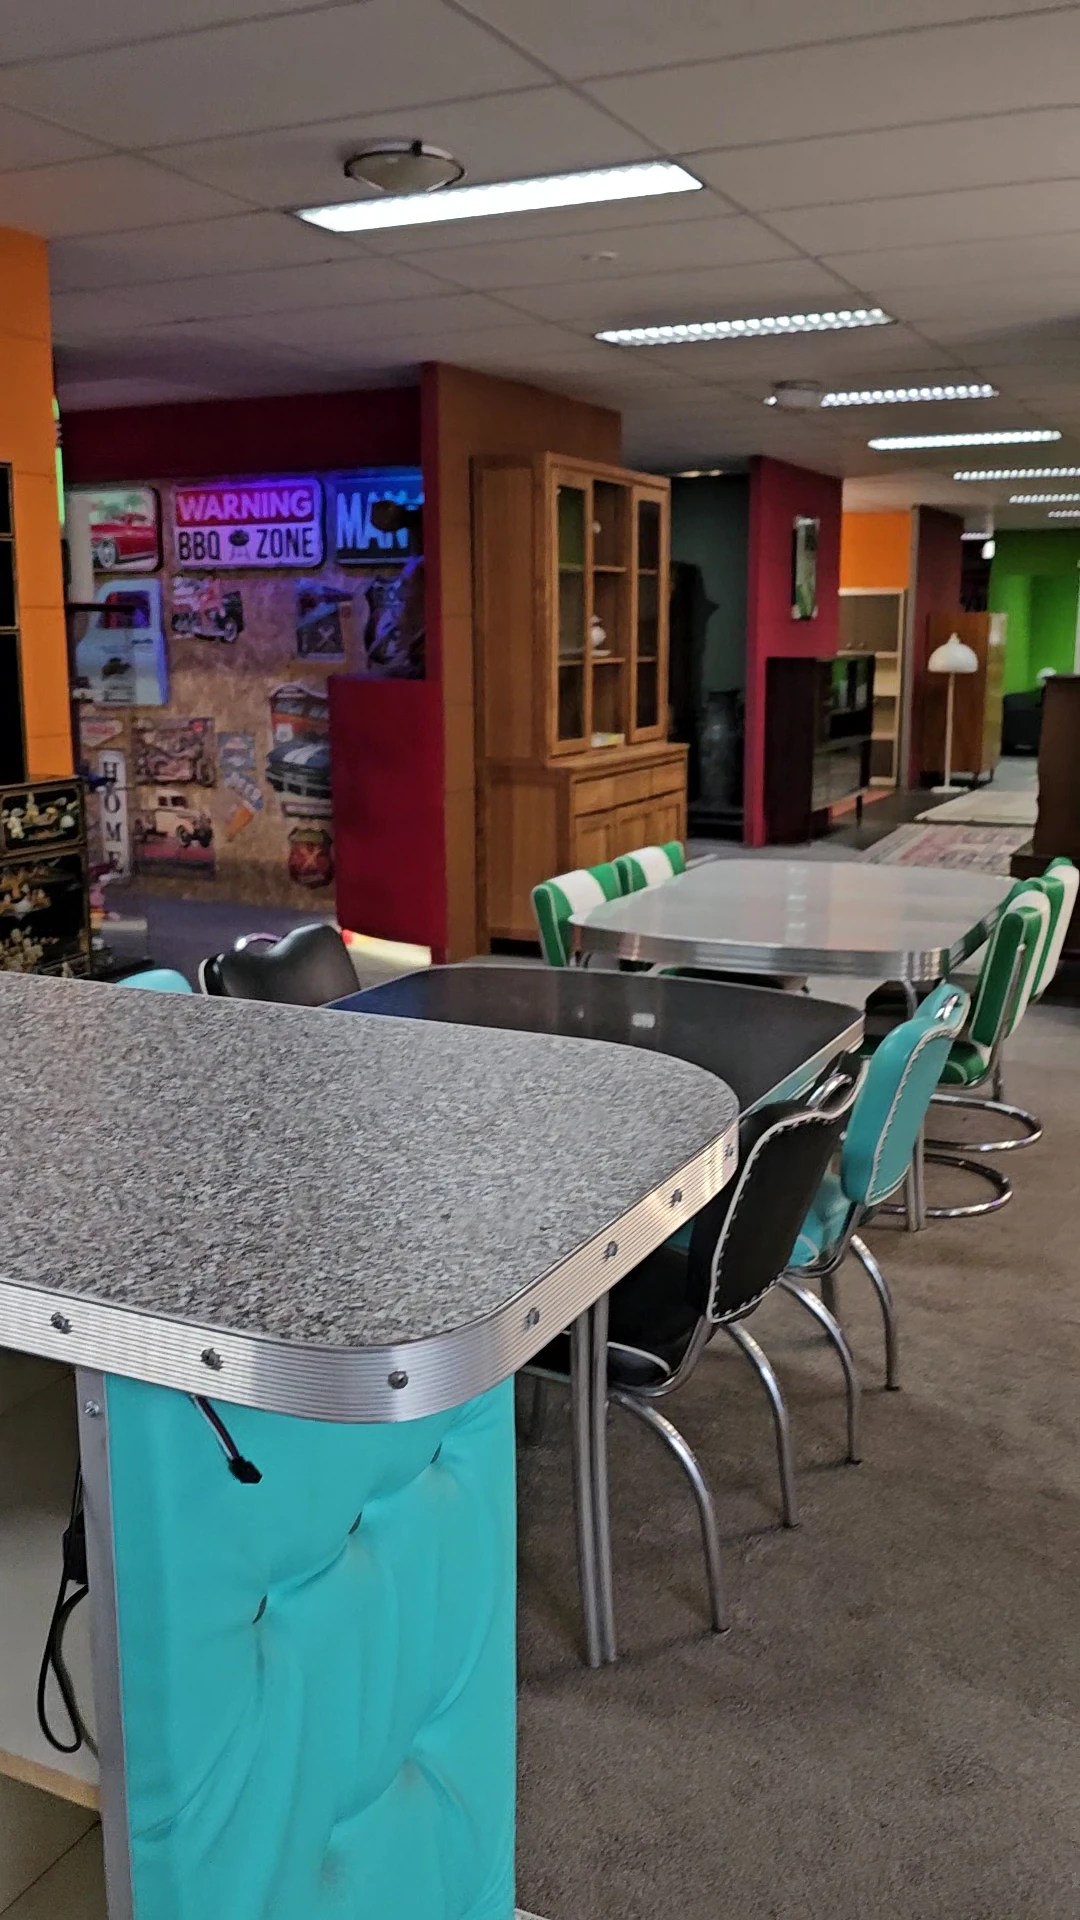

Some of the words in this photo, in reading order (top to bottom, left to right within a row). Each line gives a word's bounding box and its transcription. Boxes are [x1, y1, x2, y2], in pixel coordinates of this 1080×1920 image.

[178, 489, 313, 522] WARNING
[178, 530, 222, 561] BBQ
[256, 527, 314, 559] ZONE
[103, 761, 124, 873] HOME
